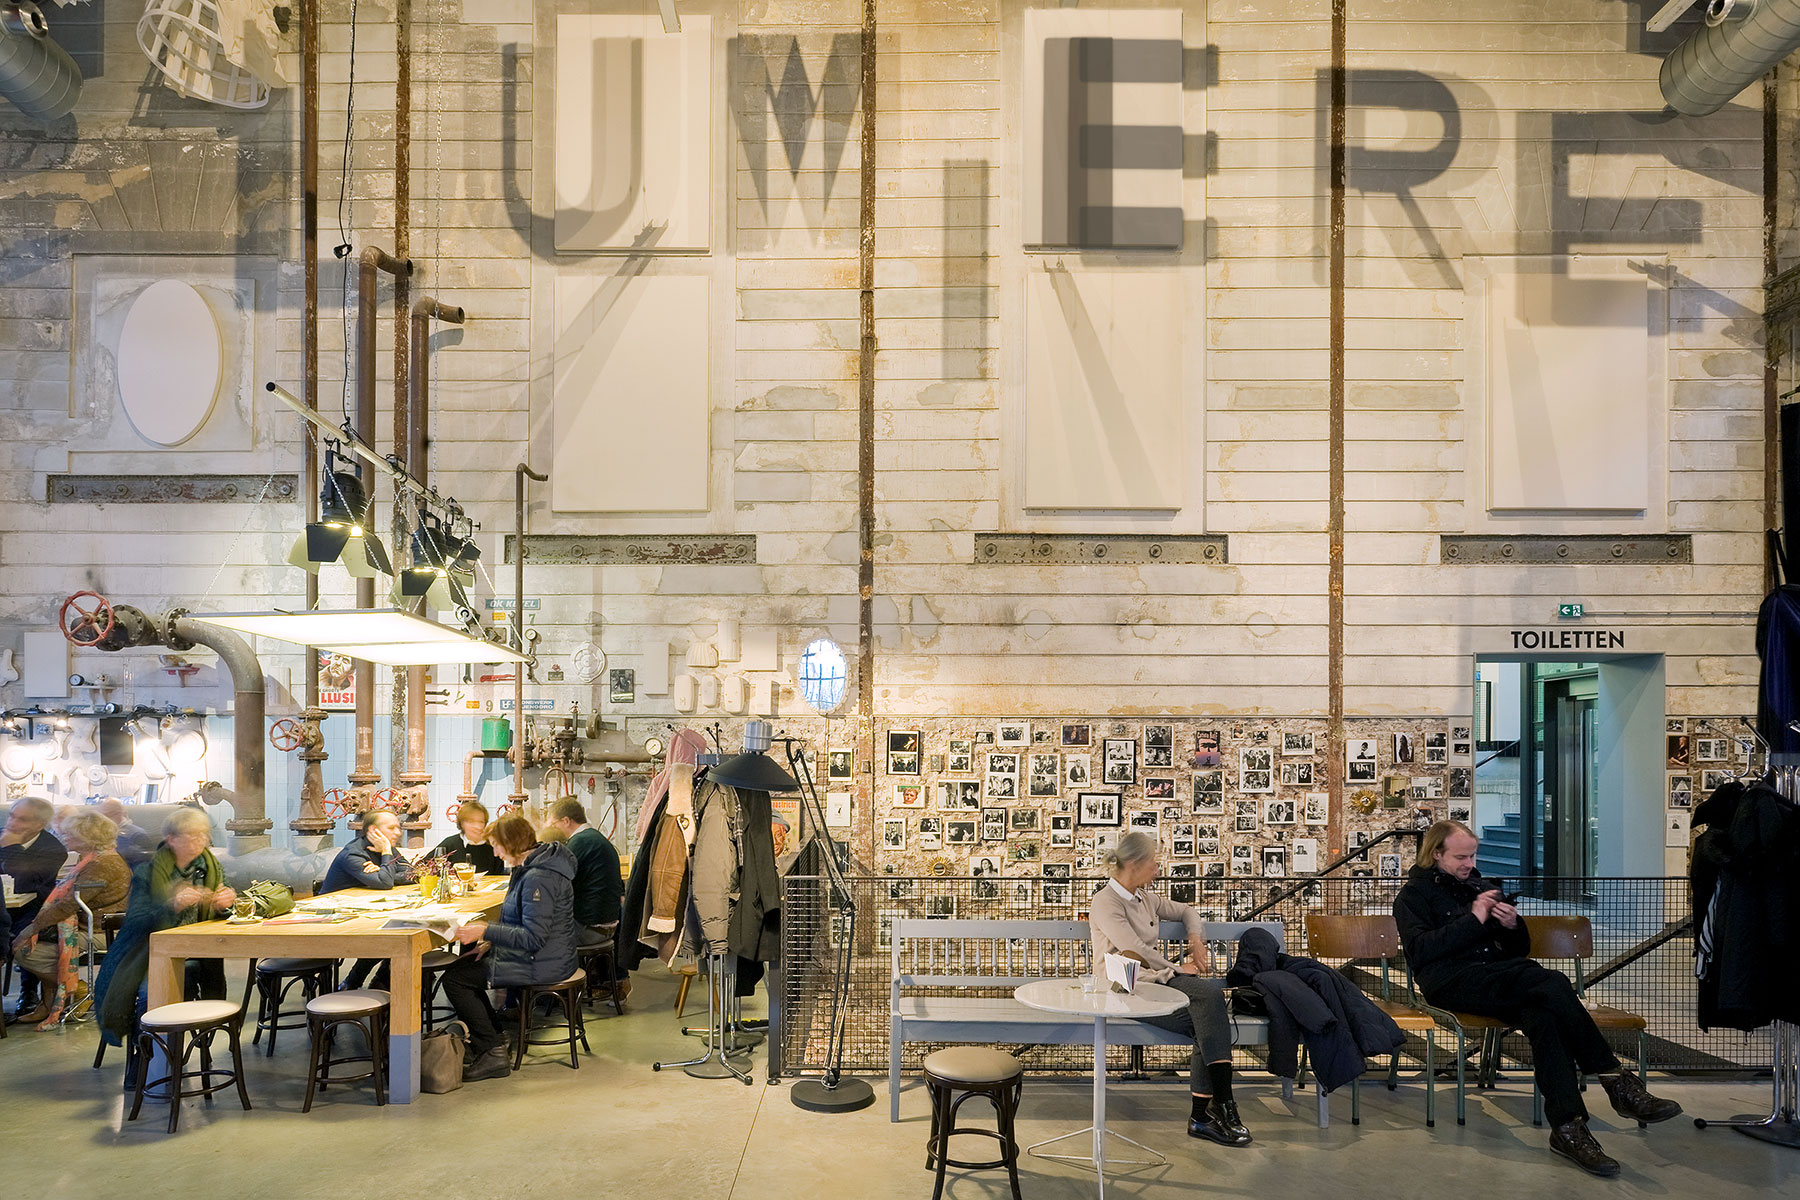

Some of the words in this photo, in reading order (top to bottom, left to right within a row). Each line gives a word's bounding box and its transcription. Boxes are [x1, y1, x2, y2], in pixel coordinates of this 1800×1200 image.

[506, 600, 536, 608] KEEL
[528, 613, 536, 625] 7
[1510, 630, 1625, 648] TOILETTEN
[485, 700, 493, 712] 9
